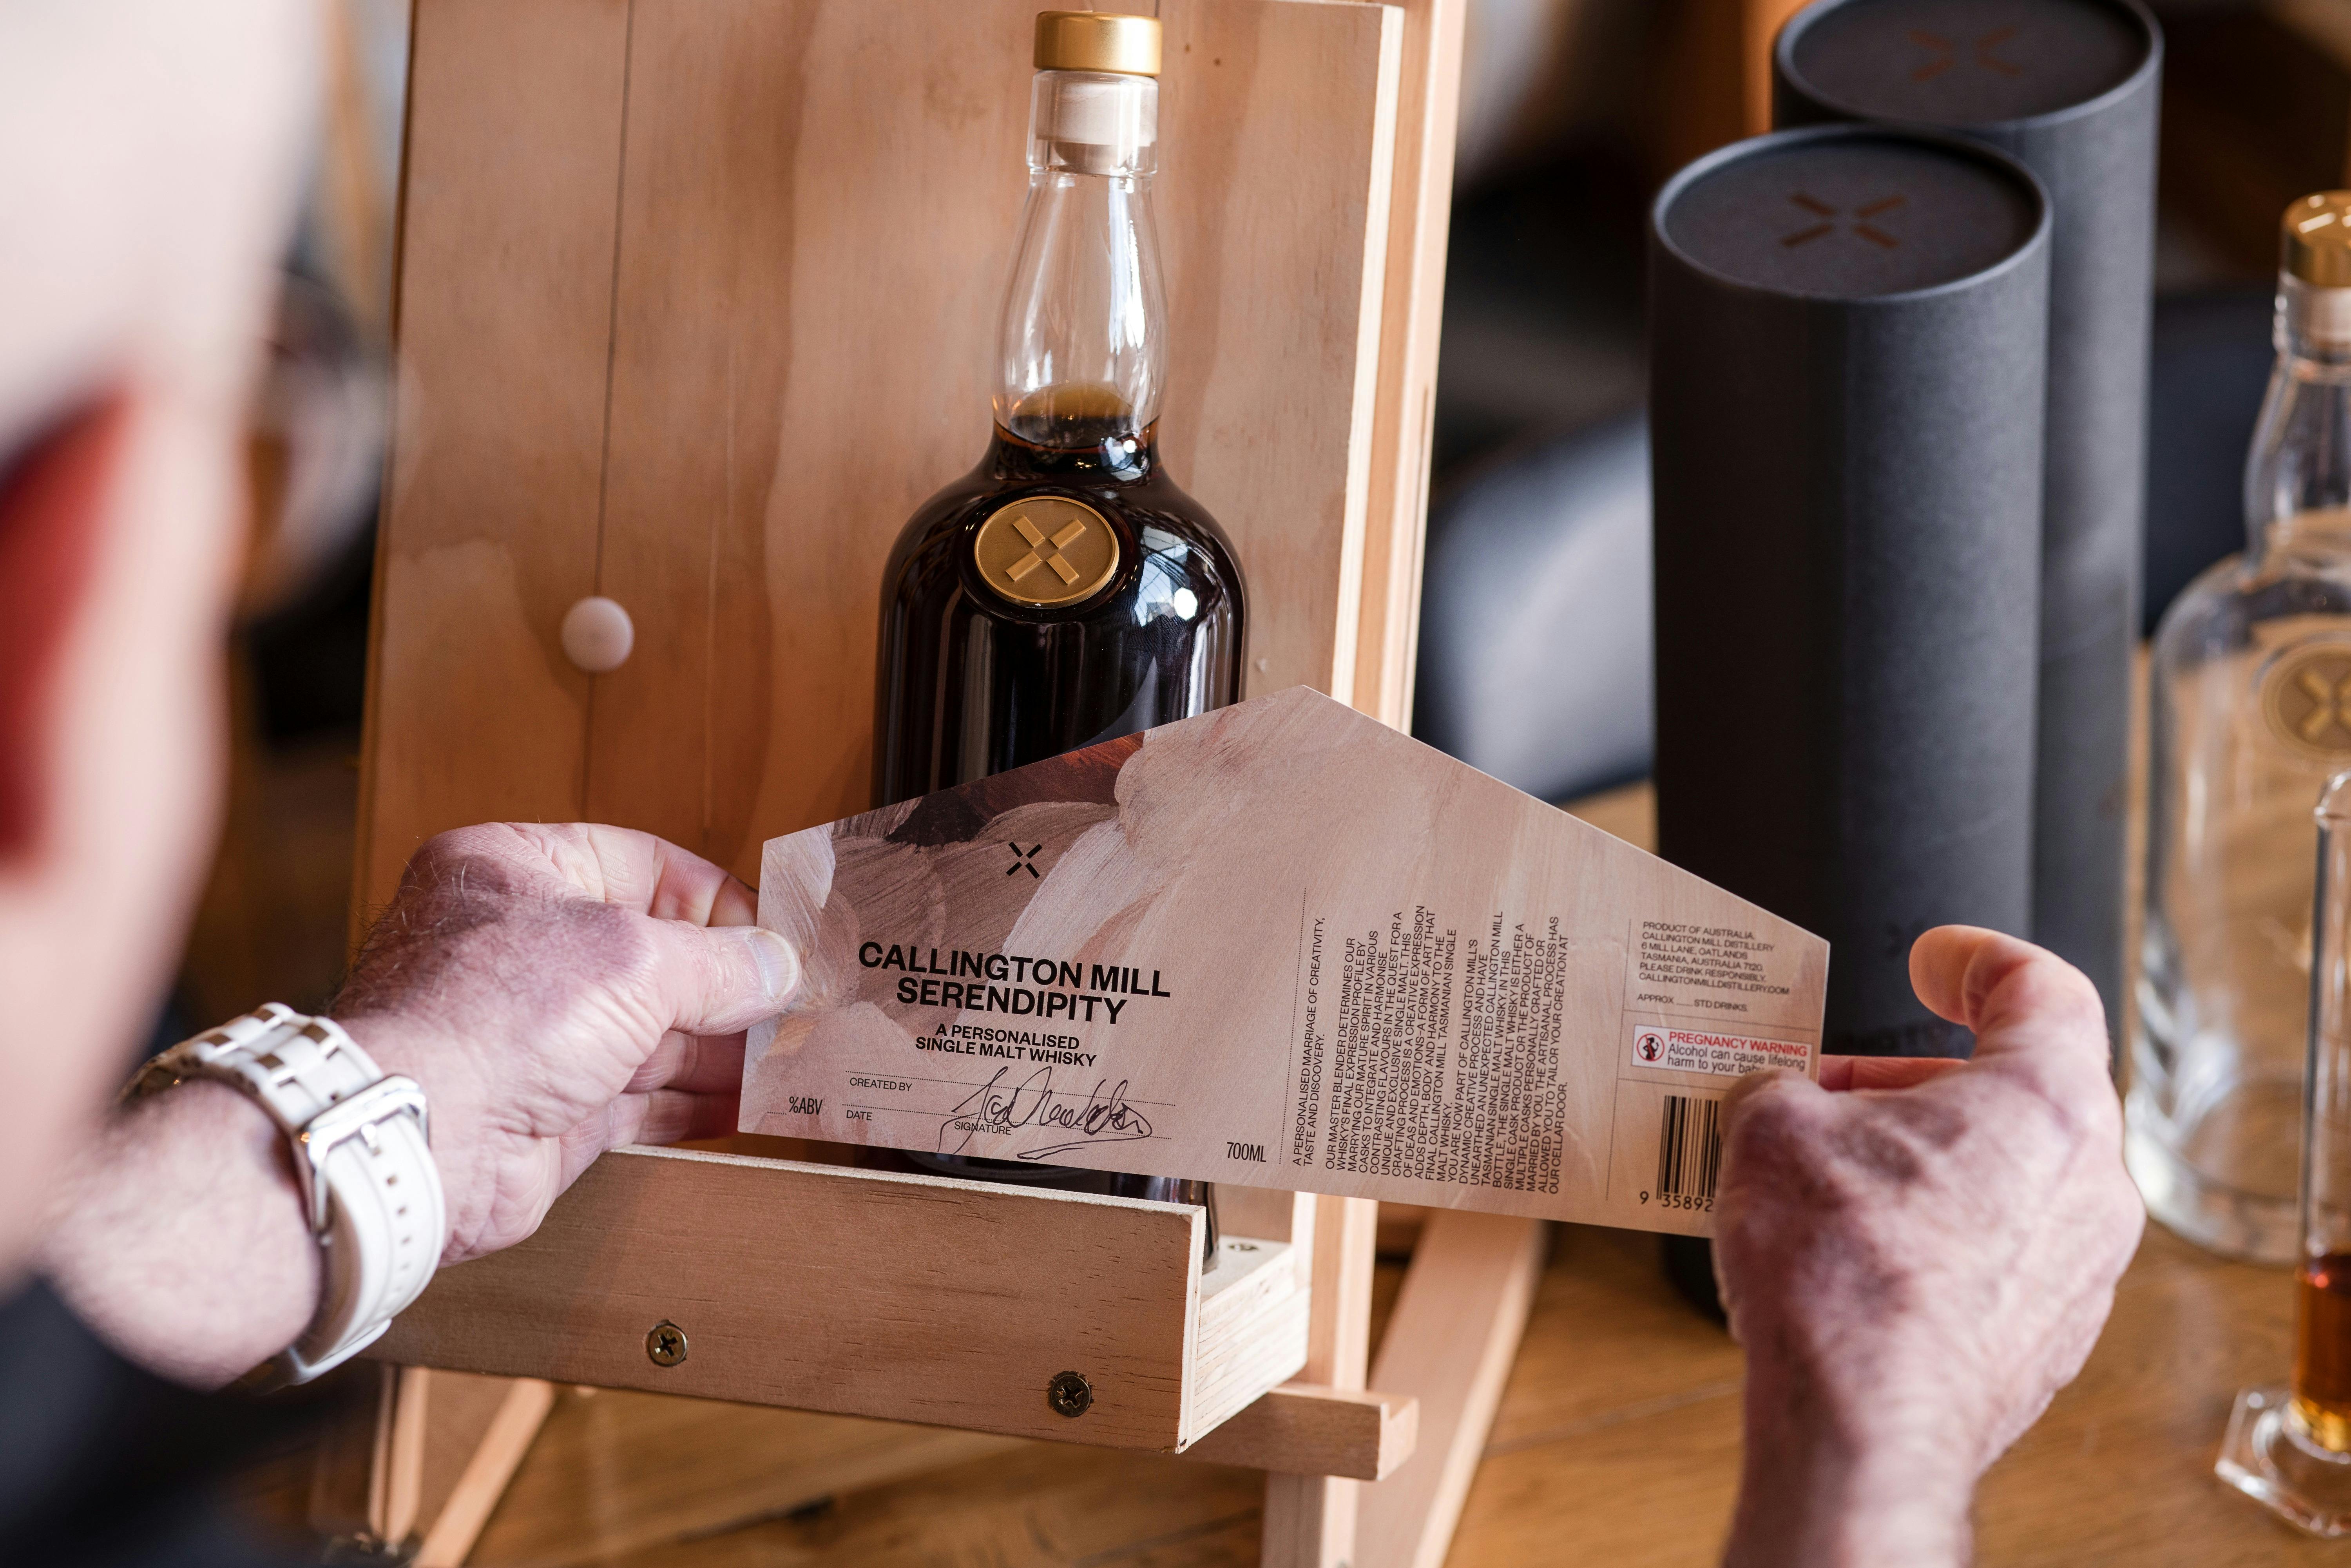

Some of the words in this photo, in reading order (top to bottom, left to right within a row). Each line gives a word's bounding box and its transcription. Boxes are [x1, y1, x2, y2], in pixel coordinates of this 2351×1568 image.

[1391, 922, 1401, 945] FOR
[1410, 905, 1425, 977] EXPRESSION
[1424, 910, 1435, 941] THAT
[1515, 923, 1524, 932] A
[1525, 933, 1534, 949] OF
[1642, 931, 1701, 944] CALLINGTON
[1701, 937, 1722, 947] MILL
[1724, 939, 1774, 951] DISTILLERY
[1643, 921, 1687, 932] PRODUCT
[1688, 925, 1701, 934] OF
[1310, 918, 1325, 986] CREATIVITY,
[1345, 938, 1355, 963] OUR
[1356, 942, 1366, 957] BY
[1365, 931, 1378, 981] VARIOUS
[1400, 933, 1411, 959] THIS
[1422, 943, 1433, 968] ART
[1434, 936, 1445, 959] THE
[1444, 929, 1456, 970] SINGLE
[1511, 934, 1523, 975] EITHER
[1641, 942, 1647, 950] 6
[1648, 942, 1669, 952] MILL
[1698, 947, 1748, 960] OATLANDS
[859, 941, 1081, 989] CALLINGTON
[1090, 964, 1171, 998] MILL
[1387, 947, 1399, 986] QUEST
[1397, 962, 1409, 994] MALT.
[1420, 969, 1430, 985] OF
[1432, 961, 1442, 977] TO
[1476, 954, 1488, 985] HAVE
[1500, 951, 1511, 977] THIS
[1639, 961, 1674, 973] PLEASE
[1675, 965, 1703, 976] DRINK
[1691, 957, 1742, 969] AUSTRALIA
[1352, 959, 1365, 1006] PROFILE
[1364, 983, 1373, 994] IN
[1373, 952, 1387, 1020] HARMONISE
[1499, 980, 1508, 990] IN
[1510, 978, 1520, 987] IS
[1520, 951, 1533, 1008] PRODUCT
[897, 977, 1127, 1025] SERENDIPITY
[1308, 988, 1317, 1004] OF
[1338, 965, 1353, 1037] DETERMINES
[1384, 988, 1396, 1011] THE
[1405, 979, 1418, 1036] CREATIVE
[1417, 987, 1429, 1020] FORM
[1427, 980, 1440, 1039] HARMONY
[1438, 972, 1453, 1040] TASMANIAN
[1474, 988, 1485, 1013] AND
[1506, 989, 1518, 1034] WHISKY
[1637, 994, 1674, 1004] APPROX
[1694, 999, 1713, 1008] STD
[1360, 996, 1372, 1032] SPIRIT
[1383, 1014, 1393, 1025] IN
[1393, 996, 1406, 1037] SINGLE
[1460, 976, 1475, 1050] CALLINGTON
[1494, 993, 1507, 1038] WHISKY.
[1517, 1010, 1529, 1033] THE
[935, 1023, 947, 1036] A
[951, 1025, 1080, 1050] PERSONALISED
[1302, 1006, 1316, 1066] MARRIAGE
[1345, 1008, 1360, 1079] EXPRESSION
[1371, 1022, 1381, 1048] AND
[1404, 1038, 1413, 1047] A
[1469, 1015, 1483, 1069] PROCESS
[1516, 1035, 1526, 1053] OR
[1669, 1032, 1747, 1050] PREGNANCY
[1750, 1040, 1807, 1056] WARNING
[915, 1036, 976, 1055] SINGLE
[979, 1043, 1026, 1059] MALT
[1029, 1048, 1097, 1067] WHISKY
[1333, 1039, 1346, 1093] BLENDER
[1356, 1034, 1369, 1081] MATURE
[1378, 1027, 1392, 1088] FLAVOURS
[1403, 1048, 1413, 1059] IS
[1425, 1041, 1435, 1066] AND
[1435, 1043, 1447, 1068] MILL
[1458, 1052, 1467, 1068] OF
[1491, 1040, 1503, 1072] MALT
[1503, 1036, 1514, 1068] MALT
[1667, 1055, 1694, 1068] harm
[1698, 1059, 1708, 1070] to
[1712, 1061, 1734, 1074] your
[1668, 1043, 1707, 1057] Alcohol
[1711, 1050, 1730, 1060] can
[1734, 1052, 1765, 1064] cause
[1768, 1052, 1805, 1072] lifelong
[1310, 1034, 1325, 1101] DISCOVERY.
[1364, 1050, 1379, 1114] INTEGRATE
[1387, 1039, 1402, 1103] EXCLUSIVE
[1511, 1054, 1524, 1111] PRODUCT
[849, 1077, 897, 1090] CREATED
[898, 1082, 913, 1092] BY
[1342, 1082, 1354, 1115] FINAL
[1354, 1084, 1364, 1108] OUR
[1398, 1061, 1411, 1115] PROCESS
[1421, 1068, 1433, 1101] BODY
[1455, 1070, 1466, 1101] PART
[1464, 1072, 1478, 1128] CREATIVE
[1487, 1074, 1500, 1116] SINGLE
[1499, 1070, 1512, 1112] SINGLE
[789, 1096, 823, 1115] %ABV
[846, 1110, 873, 1121] DATE
[1293, 1068, 1310, 1155] PERSONALISED
[1308, 1103, 1318, 1128] AND
[1328, 1095, 1341, 1142] MASTER
[1385, 1104, 1396, 1130] AND
[1408, 1099, 1419, 1124] AND
[1429, 1071, 1444, 1145] CALLINGTON
[1453, 1102, 1463, 1131] NOW
[954, 1121, 1012, 1135] SIGNATURE
[1362, 1116, 1373, 1132] TO
[1369, 1090, 1386, 1174] CONTRASTING
[1417, 1103, 1431, 1144] DEPTH,
[1440, 1102, 1453, 1148] WHISKY.
[1497, 1114, 1508, 1137] THE
[1508, 1114, 1519, 1145] CASK
[1227, 1142, 1266, 1162] 700ML
[1303, 1130, 1315, 1167] TASTE
[1325, 1144, 1336, 1170] OUR
[1347, 1111, 1362, 1172] MARRYING
[1358, 1134, 1371, 1173] CASKS
[1380, 1132, 1393, 1175] UNIQUE
[1392, 1117, 1406, 1177] CRAFTING
[1405, 1126, 1416, 1160] IDEAS
[1450, 1133, 1461, 1157] ARE
[1459, 1130, 1473, 1184] DYNAMIC
[1481, 1118, 1496, 1186] TASMANIAN
[1293, 1158, 1302, 1166] A
[1403, 1162, 1413, 1178] OF
[1414, 1147, 1426, 1179] ADDS
[1425, 1148, 1437, 1181] FINAL
[1436, 1150, 1448, 1182] MALT
[1447, 1158, 1458, 1182] YOU
[1492, 1140, 1507, 1188] BOTTLE,
[1503, 1148, 1516, 1190] SINGLE
[1640, 1191, 1649, 1204] 9
